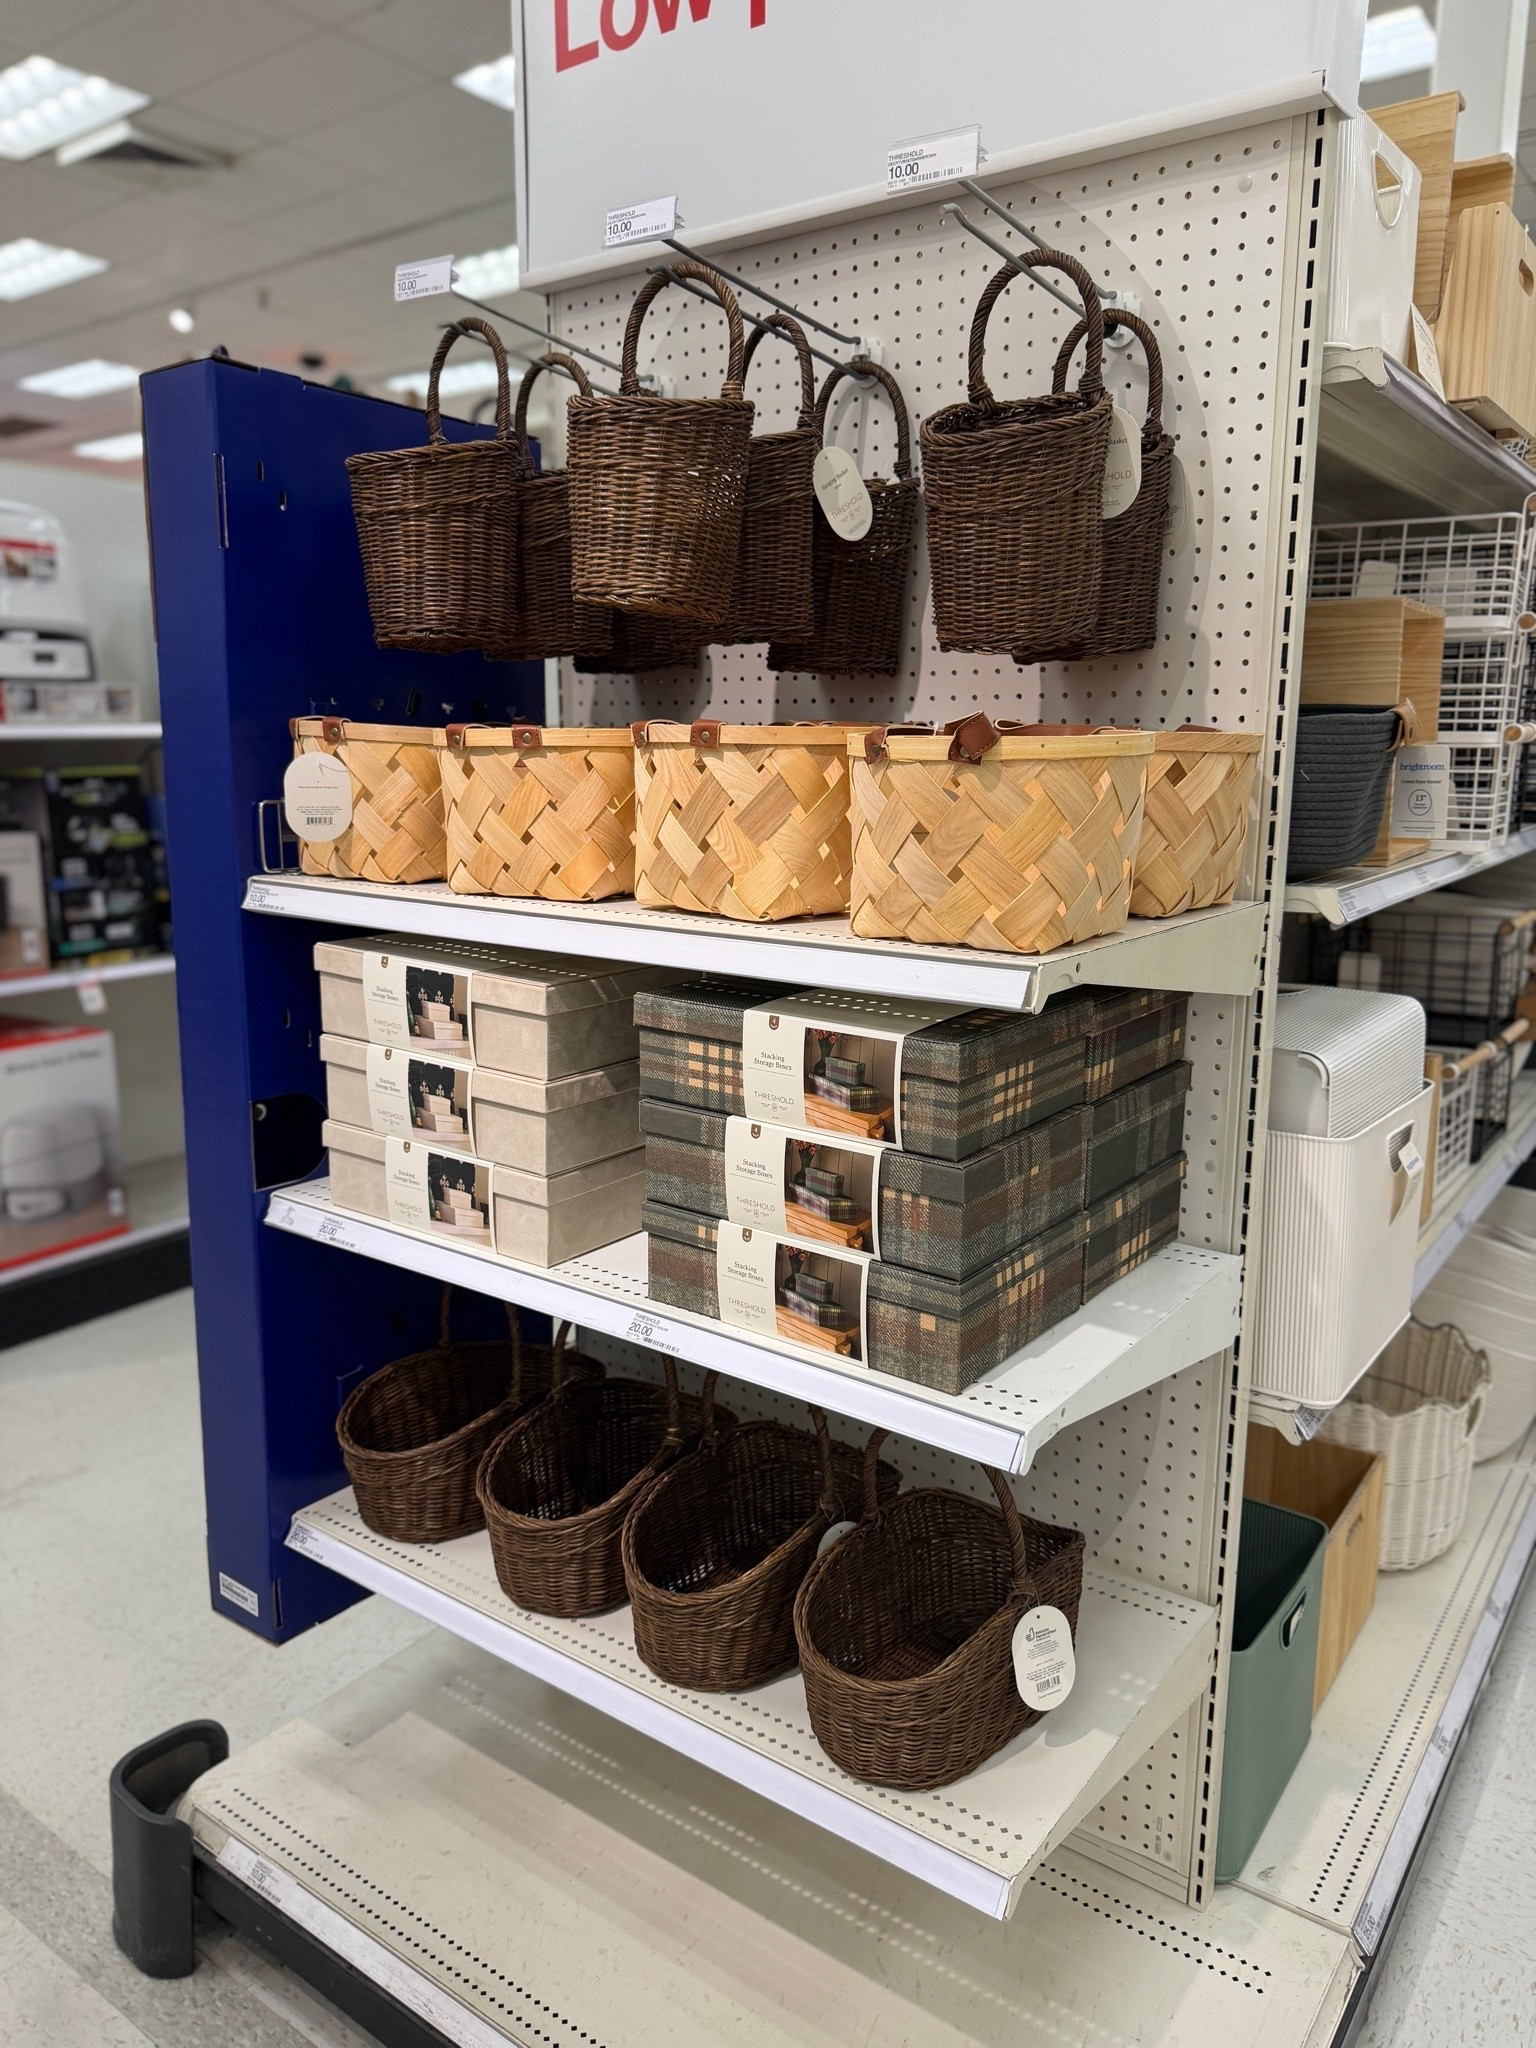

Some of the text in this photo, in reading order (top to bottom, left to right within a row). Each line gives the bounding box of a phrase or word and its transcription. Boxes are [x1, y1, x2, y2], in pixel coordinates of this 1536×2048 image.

[889, 149, 924, 162] THRESHOLD
[889, 162, 919, 180] 10.00
[608, 209, 636, 221] THRESHOLD
[608, 220, 632, 236] 10.00
[398, 279, 417, 292] 10.00
[831, 492, 863, 519] THRESHOLD
[1400, 762, 1446, 773] brightroom
[250, 894, 267, 904] 10.00
[373, 1018, 402, 1030] THRESHOLD
[760, 1051, 785, 1063] Stacking
[754, 1058, 792, 1071] Storage Boxes
[754, 1090, 795, 1105] THRESHOLD
[735, 1164, 773, 1179] Storage Boxes
[742, 1158, 767, 1171] Stacking
[736, 1196, 776, 1212] THRESHOLD
[319, 1224, 338, 1237] 20.00
[727, 1266, 764, 1283] Storage Boxes
[734, 1261, 758, 1274] Stacking
[728, 1297, 767, 1315] THRESHOLD
[635, 1312, 661, 1325] THRESHOLD
[628, 1321, 653, 1337] 20.00
[291, 1530, 308, 1545] 20.00
[250, 1868, 267, 1884] 10.00
[1363, 1915, 1376, 1941] 25.00
